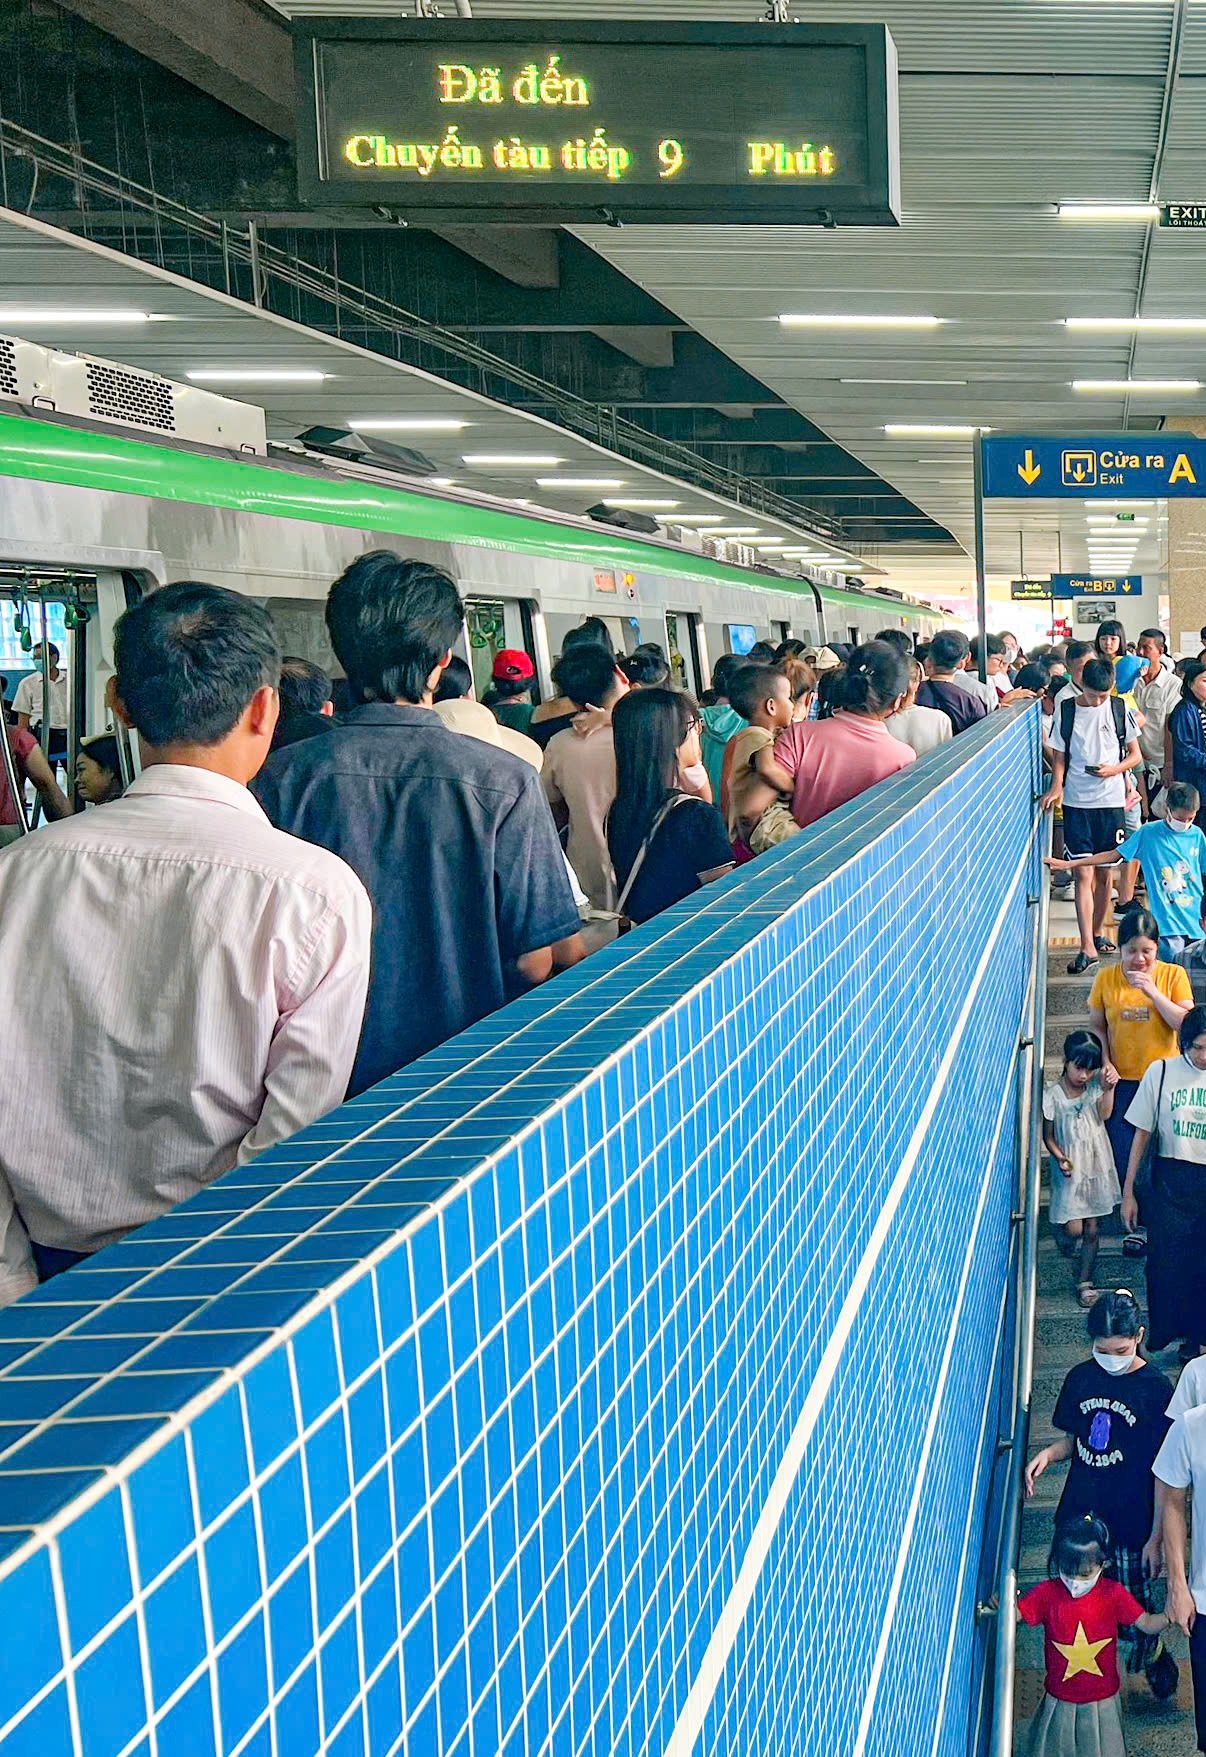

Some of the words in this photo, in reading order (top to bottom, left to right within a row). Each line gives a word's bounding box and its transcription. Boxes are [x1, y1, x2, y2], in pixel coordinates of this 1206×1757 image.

[438, 64, 503, 103] Đã
[513, 56, 590, 104] đến
[346, 126, 483, 176] Chuyến
[493, 137, 551, 168] tàu
[561, 128, 630, 177] tiếp
[658, 140, 684, 177] 9
[748, 143, 834, 175] Phút
[1100, 450, 1140, 468] Cửa
[1145, 455, 1164, 468] ra
[1168, 453, 1197, 483] A
[1100, 473, 1124, 484] Exit
[1093, 580, 1103, 592] B
[1115, 829, 1125, 844] C
[1170, 1088, 1188, 1112] LOS
